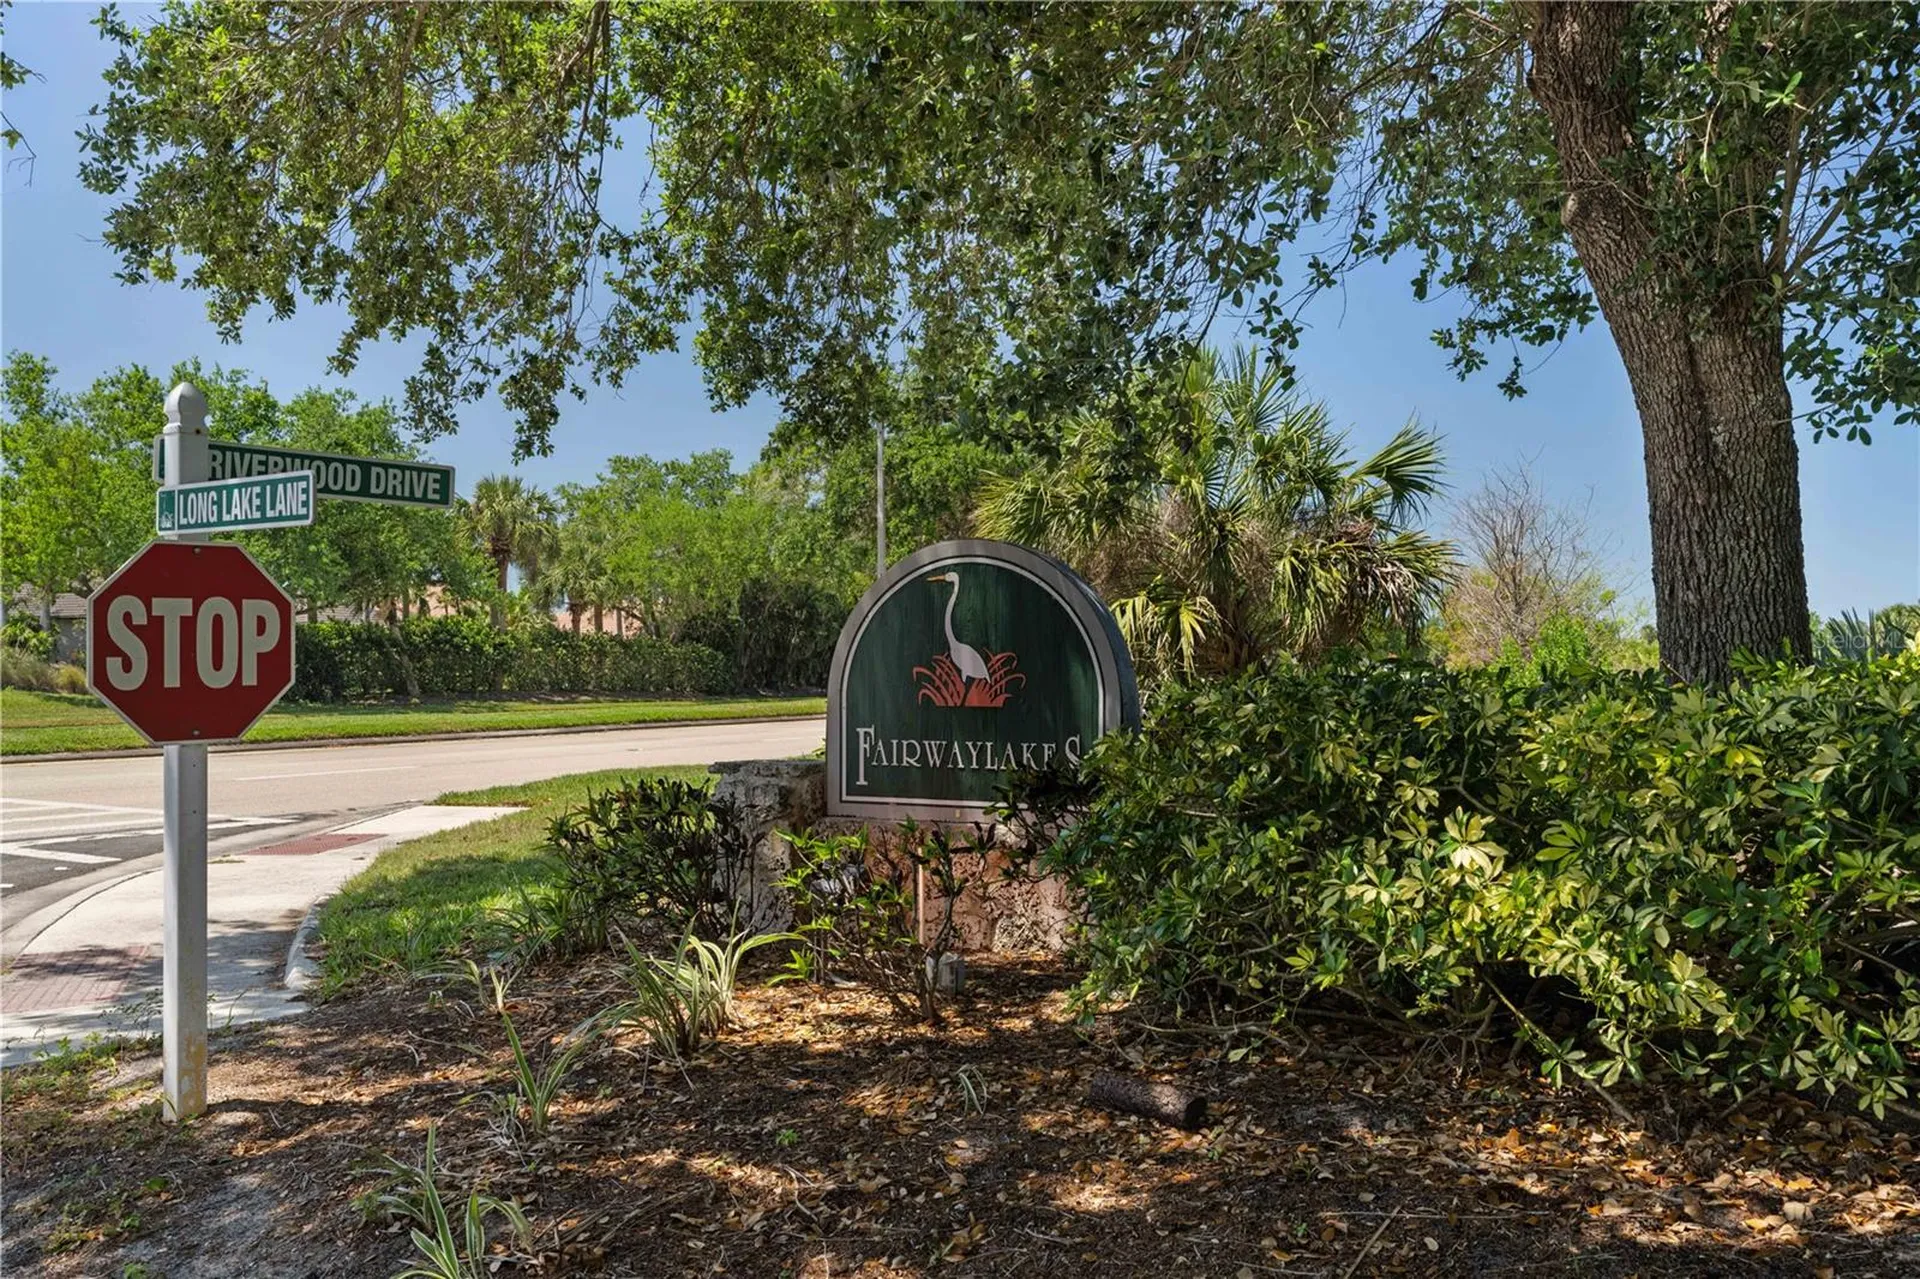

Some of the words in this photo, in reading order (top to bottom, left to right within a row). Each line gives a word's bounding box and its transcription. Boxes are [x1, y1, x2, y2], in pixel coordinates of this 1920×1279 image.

[179, 490, 217, 524] LONG
[222, 485, 261, 519] LAKE
[265, 480, 308, 516] LANE
[370, 466, 441, 500] DRIVE
[106, 595, 281, 691] STOP
